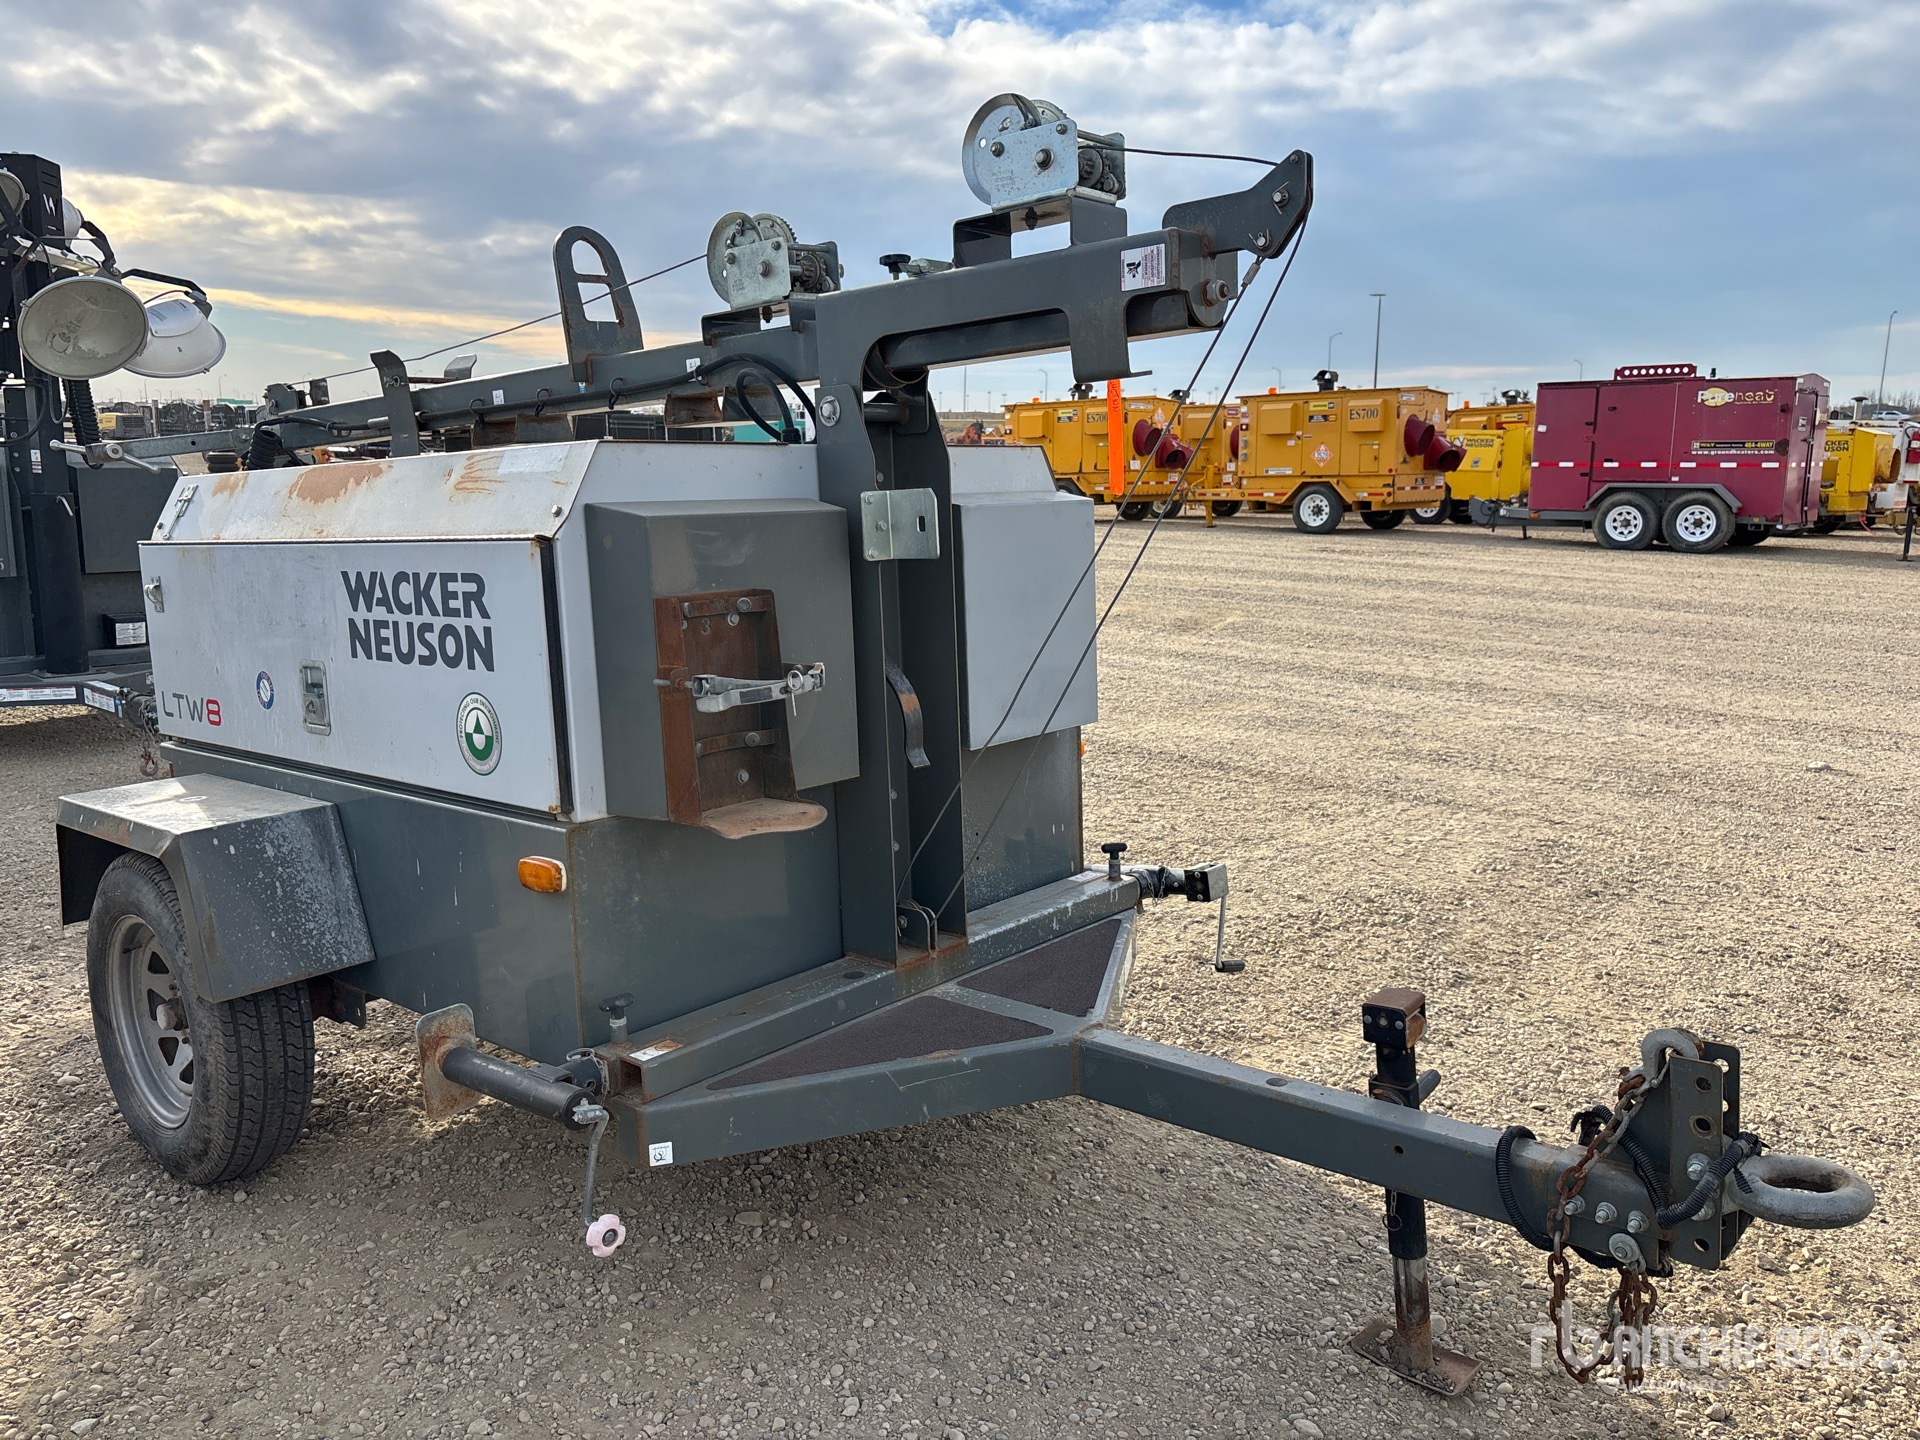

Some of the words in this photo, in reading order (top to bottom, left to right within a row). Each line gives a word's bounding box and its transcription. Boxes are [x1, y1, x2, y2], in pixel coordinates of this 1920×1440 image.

[1349, 408, 1379, 420] ES700
[1691, 448, 1775, 456] www.groundheaters.com
[340, 570, 492, 620] WACKER
[348, 617, 495, 673] NEUSON
[161, 690, 222, 727] LTW8
[458, 700, 470, 739] PROTECTING
[469, 697, 479, 705] OUR
[479, 698, 500, 745] ENVIRONMENT
